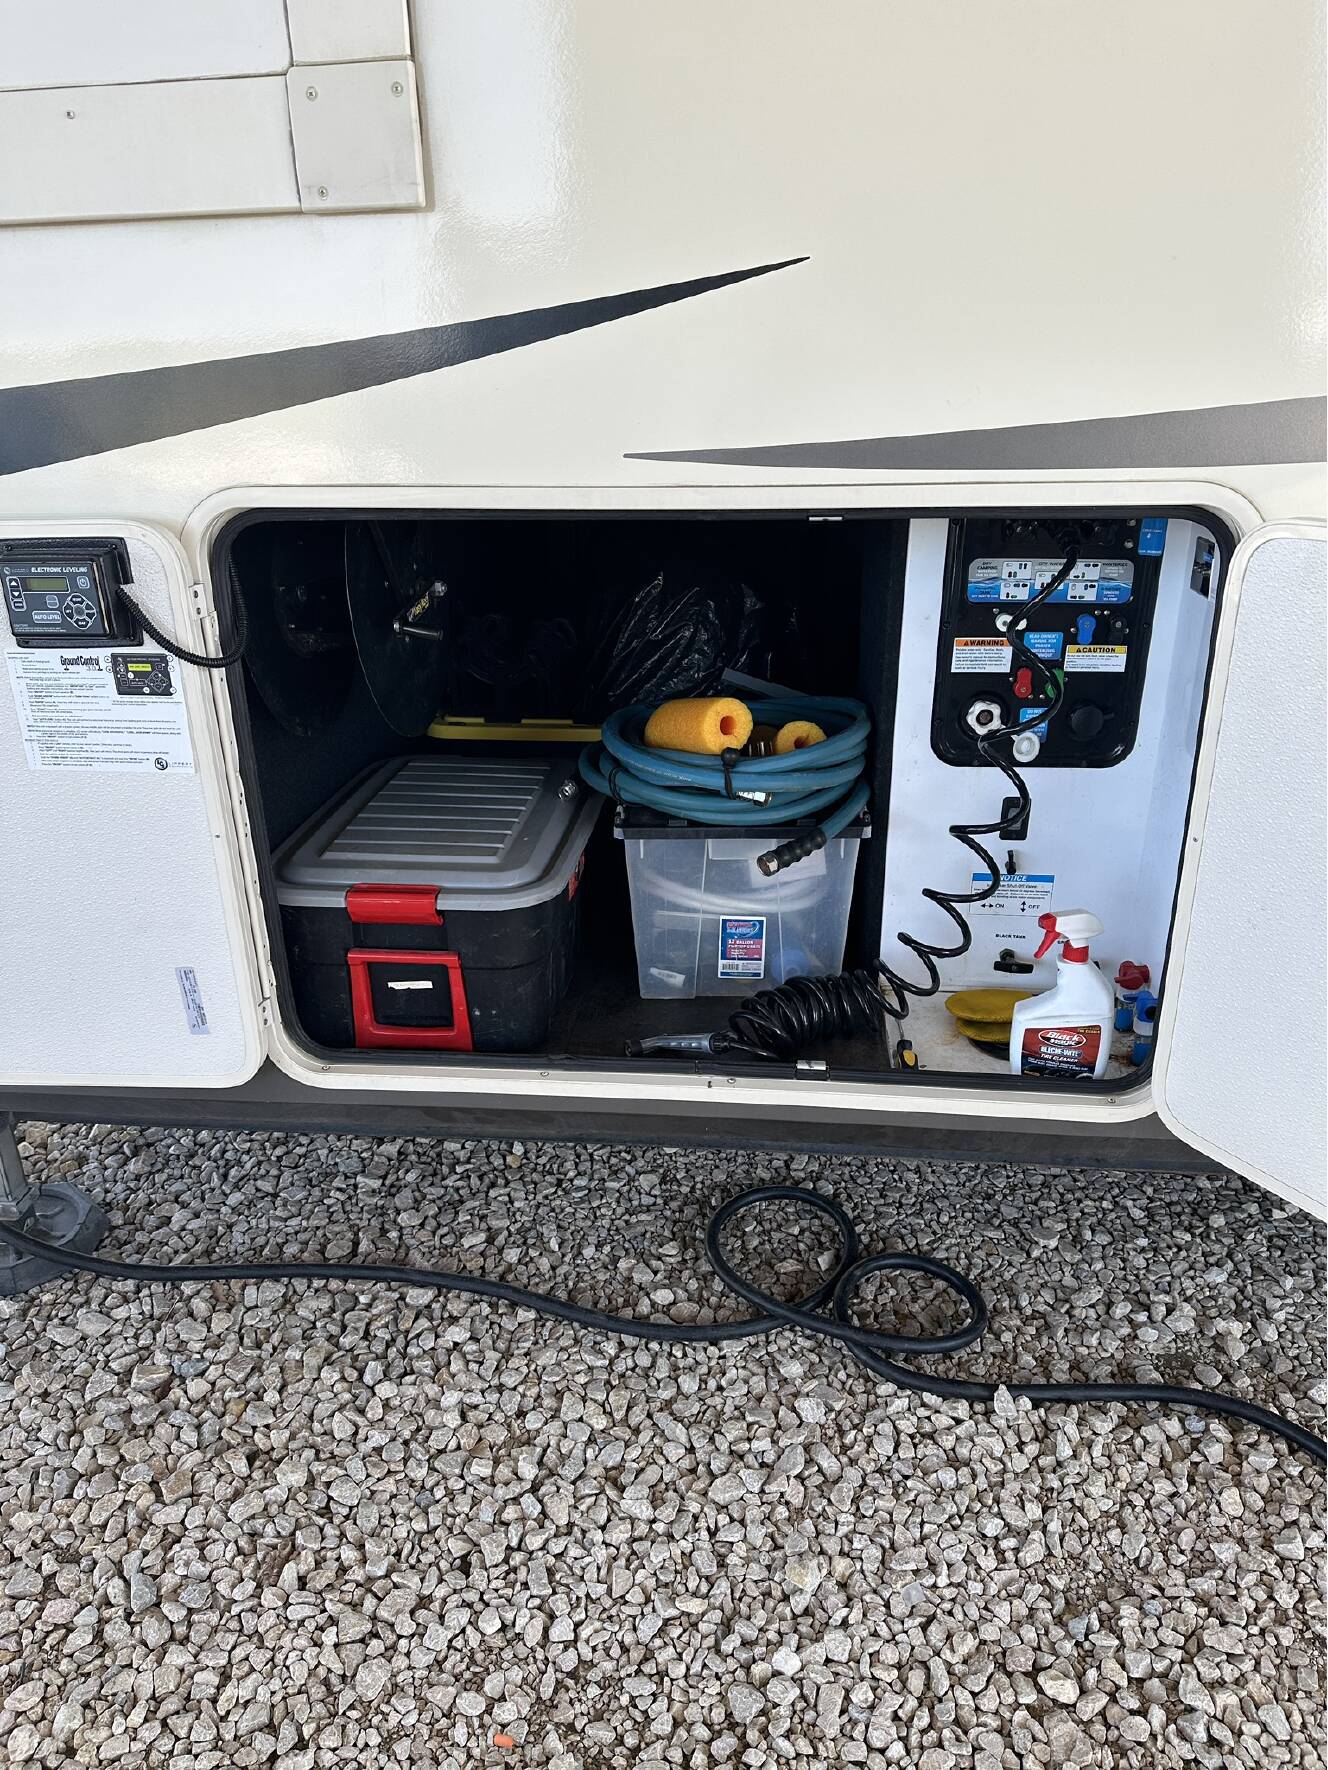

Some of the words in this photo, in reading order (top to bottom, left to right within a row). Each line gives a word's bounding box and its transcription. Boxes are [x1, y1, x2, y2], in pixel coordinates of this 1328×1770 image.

[60, 655, 80, 666] Ground
[80, 655, 100, 667] Control
[1000, 874, 1028, 882] NOTICE
[1047, 1032, 1081, 1042] Black
[1053, 1055, 1079, 1063] CLEANER
